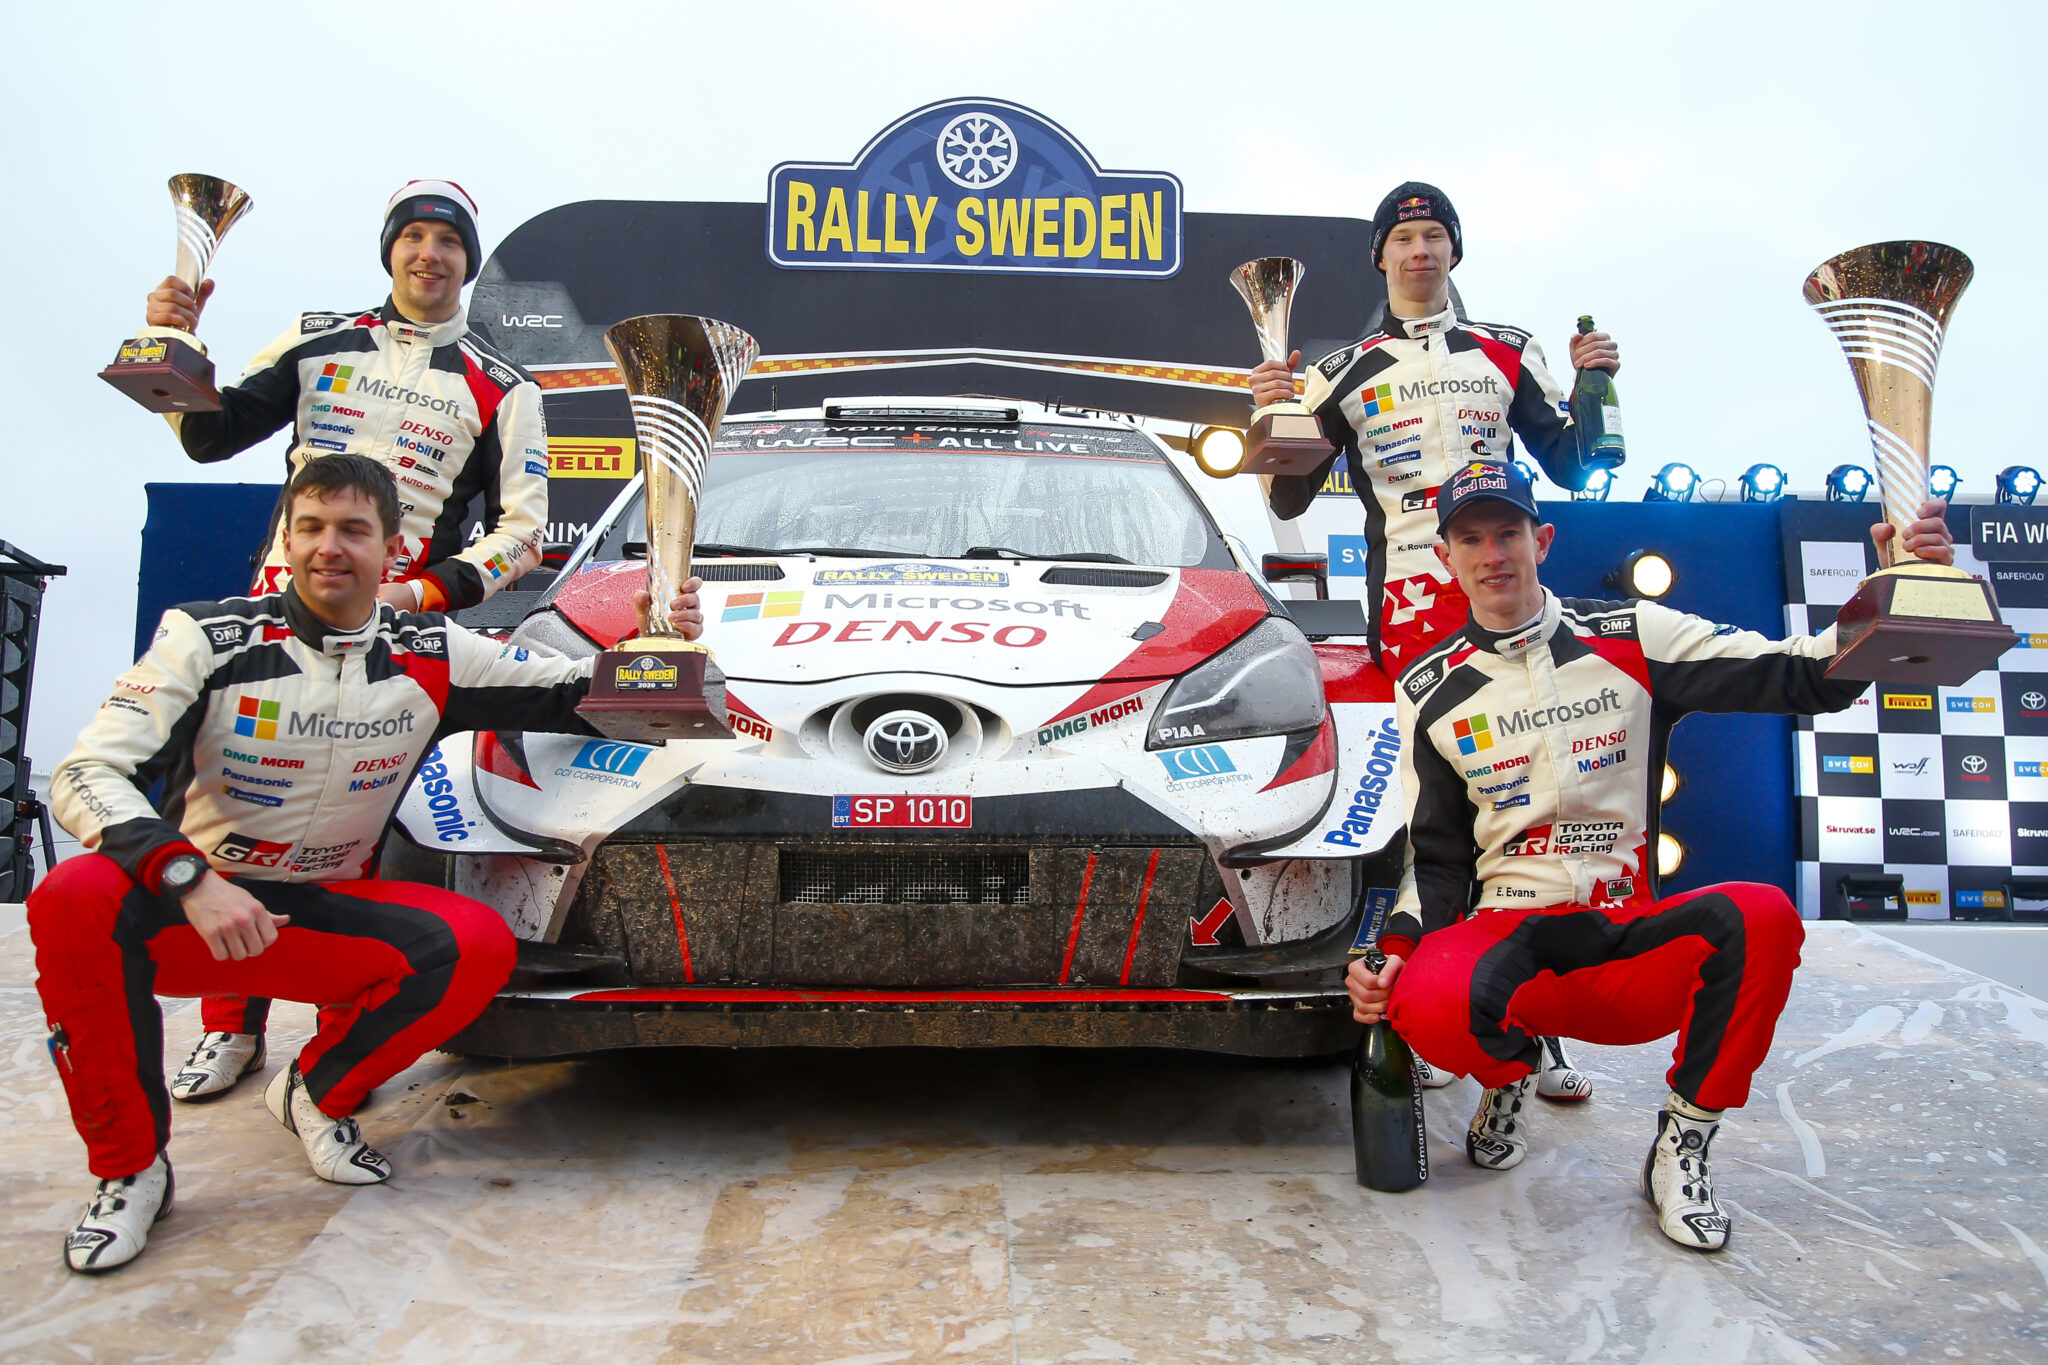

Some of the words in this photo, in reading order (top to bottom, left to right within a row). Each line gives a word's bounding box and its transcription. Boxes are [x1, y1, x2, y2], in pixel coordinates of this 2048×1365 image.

[786, 179, 939, 254] RALLY
[955, 189, 1163, 261] SWEDEN
[304, 318, 334, 330] OMP
[502, 313, 564, 329] WRC
[1498, 332, 1522, 346] OMP
[1324, 353, 1348, 373] OMP
[488, 366, 515, 385] OMP
[356, 375, 463, 420] Microsoft
[1398, 375, 1499, 402] Microsoft
[332, 405, 366, 419] MORI
[1457, 409, 1501, 423] DENSO
[400, 419, 454, 446] DENSO
[790, 425, 906, 434] TOYOTA
[914, 425, 1020, 435] GAZOO
[1026, 429, 1123, 443] Racing
[1366, 424, 1392, 439] DMG
[1392, 416, 1423, 431] MORI
[396, 436, 433, 457] Mobil
[756, 435, 896, 448] WRC
[938, 437, 1004, 450] ALL
[1014, 440, 1090, 454] LIVE
[1374, 433, 1422, 453] Panasonic
[401, 475, 424, 489] AUTO
[1319, 471, 1354, 494] ALL
[1388, 470, 1422, 485] SILVASTI
[1452, 478, 1478, 501] Red
[1479, 477, 1508, 490] Bull
[1981, 521, 2019, 545] FIA
[1408, 543, 1434, 551] Rovan
[823, 571, 894, 581] RALLY
[902, 571, 1001, 582] SWEDEN
[1809, 567, 1859, 577] SAFEROAD
[1996, 571, 2045, 582] SAFEROAD
[824, 592, 1092, 621] Microsoft
[212, 626, 243, 643] OMP
[772, 619, 1048, 648] DENSO
[1600, 619, 1631, 633] OMP
[412, 638, 442, 651] OMP
[619, 669, 642, 680] RALLY
[643, 668, 675, 680] SWEDEN
[1410, 670, 1436, 692] OMP
[1888, 697, 1928, 708] PIRELLI
[1037, 717, 1089, 746] DMG
[1090, 696, 1144, 728] MORI
[1496, 687, 1622, 738] Microsoft
[288, 708, 415, 740] Microsoft
[1158, 724, 1206, 741] PIAA
[1572, 729, 1627, 755] DENSO
[222, 748, 259, 765] DMG
[260, 757, 305, 770] MORI
[352, 752, 408, 773] DENSO
[1465, 764, 1493, 780] DMG
[1493, 754, 1531, 773] MORI
[1577, 754, 1616, 774] Mobil
[221, 767, 294, 789] Panasonic
[348, 775, 389, 793] Mobil
[554, 767, 572, 778] CCI
[572, 770, 642, 790] CORPORATION
[1166, 783, 1185, 793] CCI
[1185, 772, 1254, 791] CORPORATION
[1323, 717, 1401, 848] Panasonic
[1477, 775, 1531, 796] Panasonic
[834, 815, 850, 823] EST
[854, 798, 895, 824] SP
[905, 798, 966, 823] 1010
[1559, 821, 1625, 834] TOYOTA
[1826, 825, 1876, 835] Skruvat.se
[1889, 827, 1941, 837] WRC.com
[2017, 827, 2048, 838] Skruva
[302, 839, 361, 856] TOYOTA
[1555, 832, 1618, 845] GAZOO
[215, 843, 282, 868] GR
[294, 849, 352, 864] GAZOO
[1553, 843, 1614, 855] Racing
[1496, 886, 1504, 898] E.
[1505, 886, 1537, 899] Evans
[1417, 1122, 1428, 1182] Crémant
